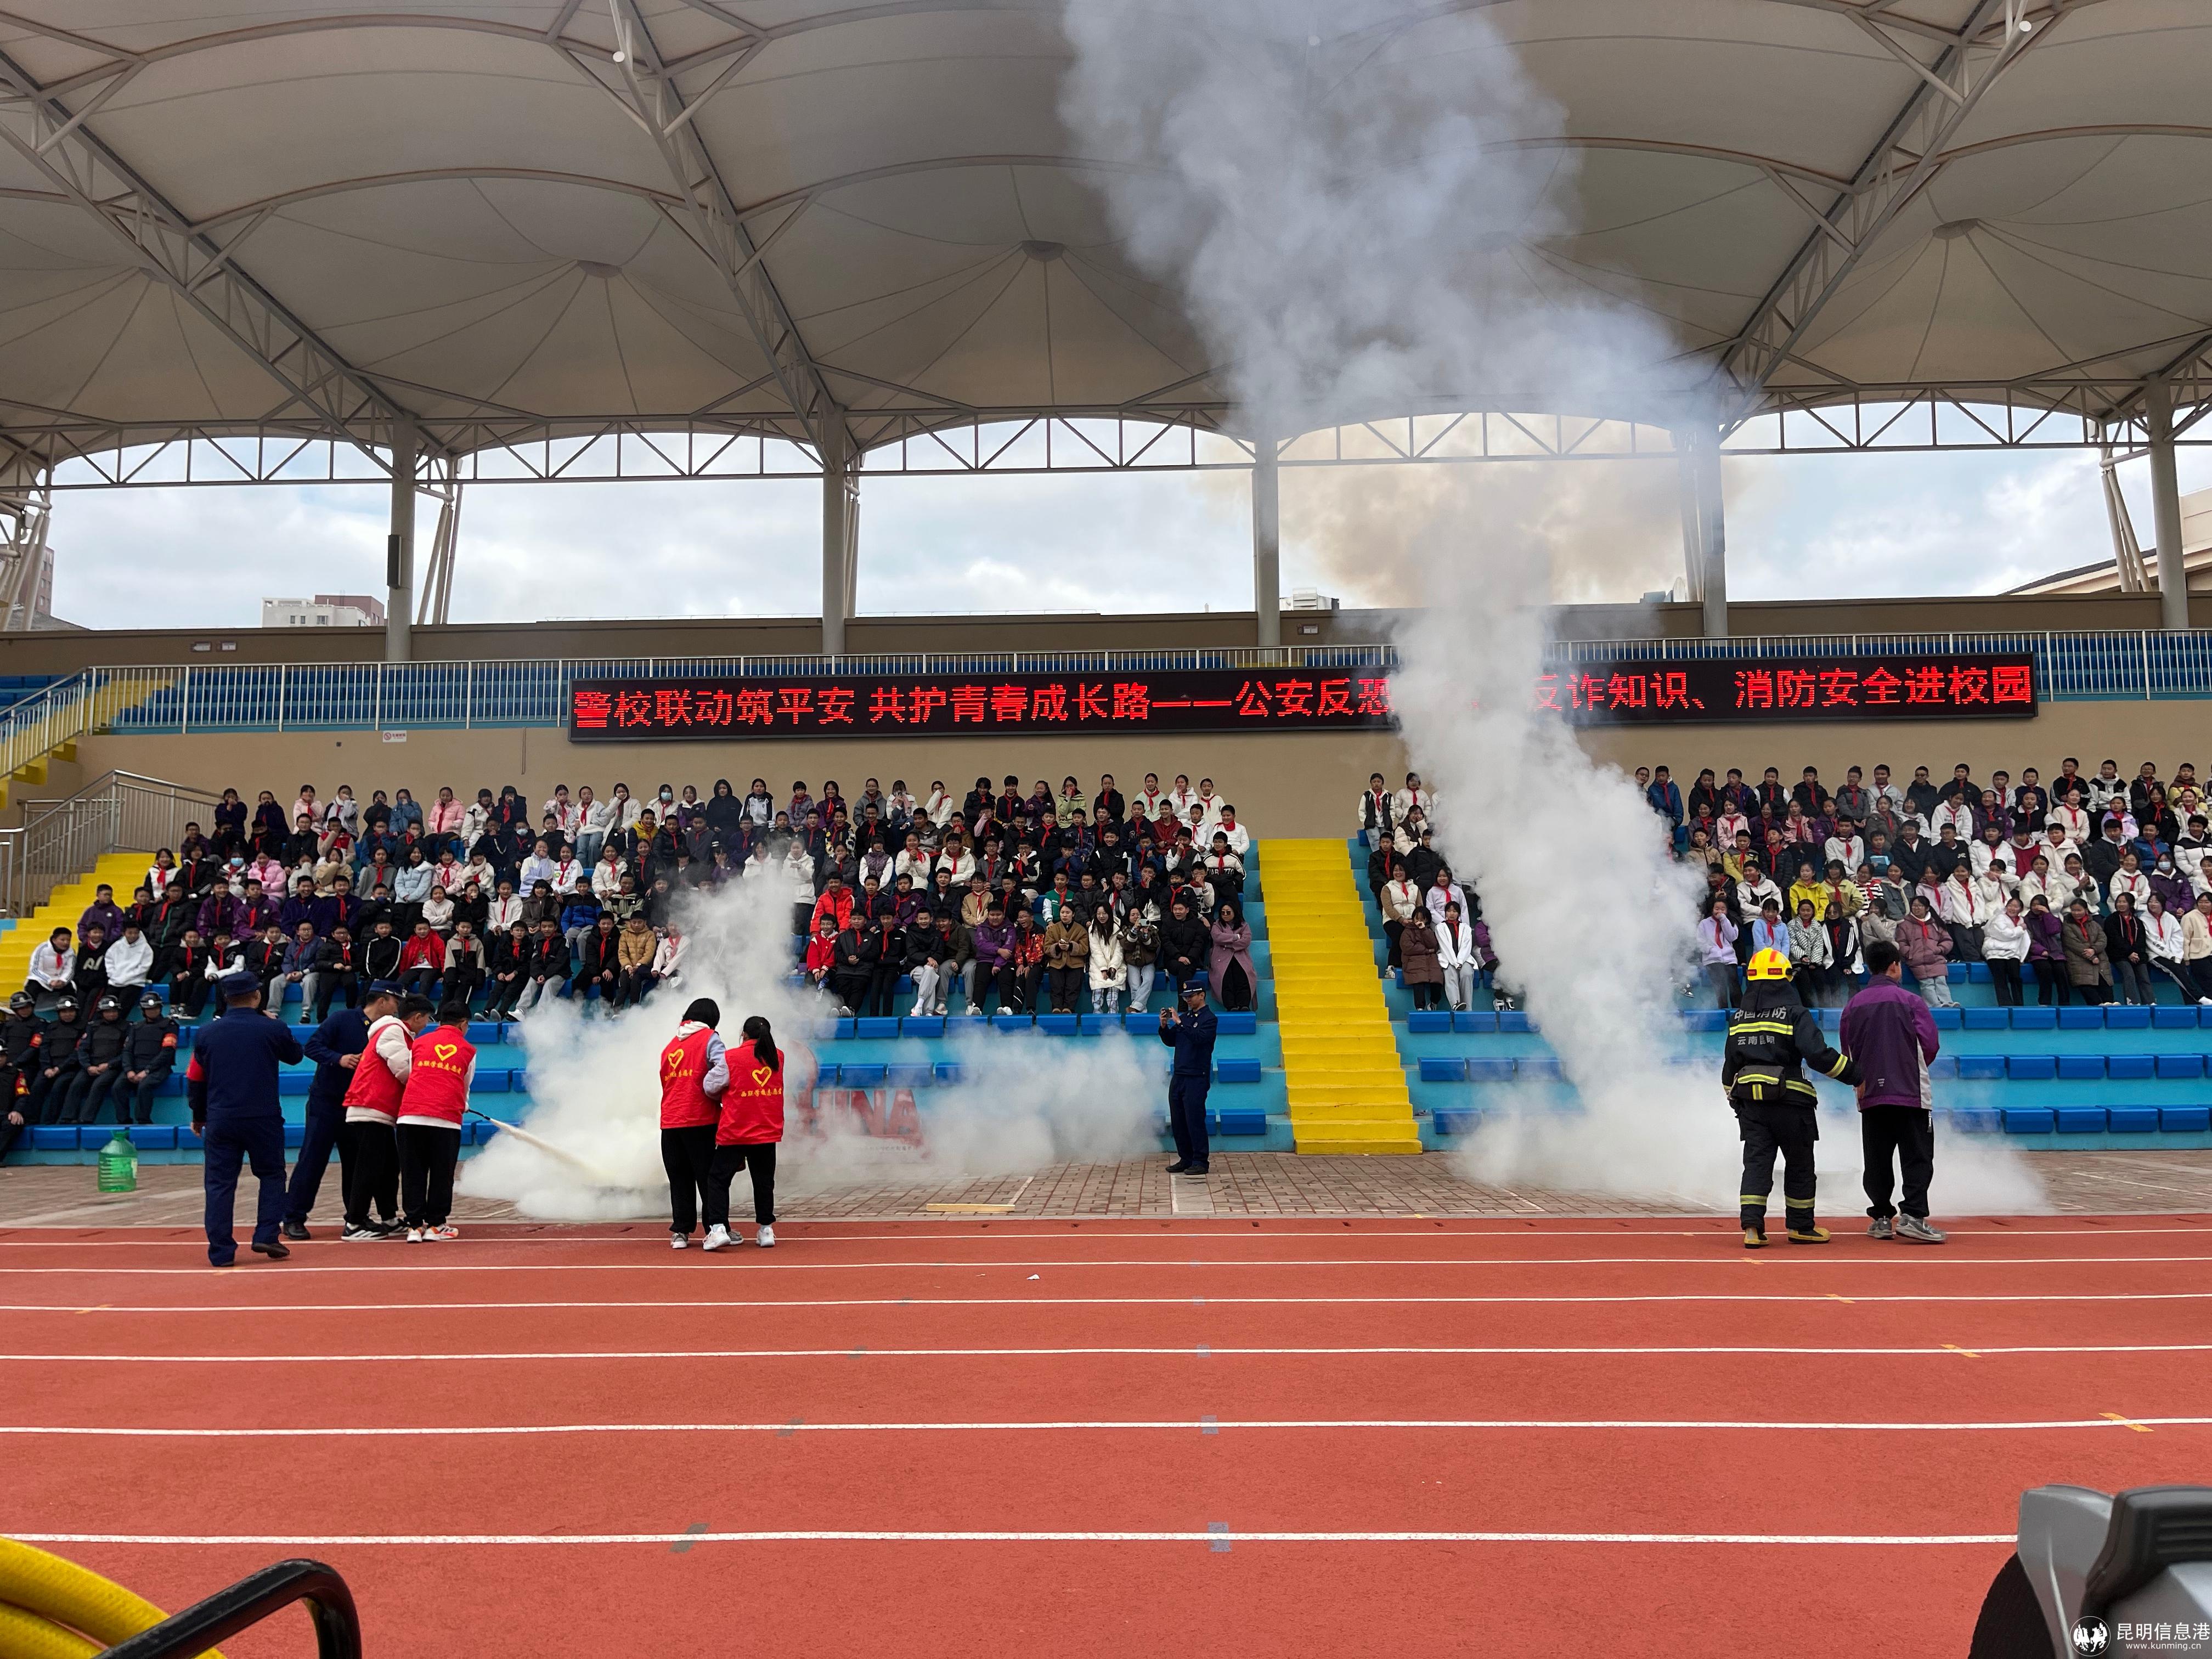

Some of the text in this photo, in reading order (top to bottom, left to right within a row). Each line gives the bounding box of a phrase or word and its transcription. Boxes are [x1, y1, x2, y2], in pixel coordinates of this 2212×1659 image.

[574, 665, 2032, 729] 警校联动筑平安 共护青春成长路——公安反恐反诈知识、消防安全进校园
[1737, 1035, 1775, 1046] 云南昆明
